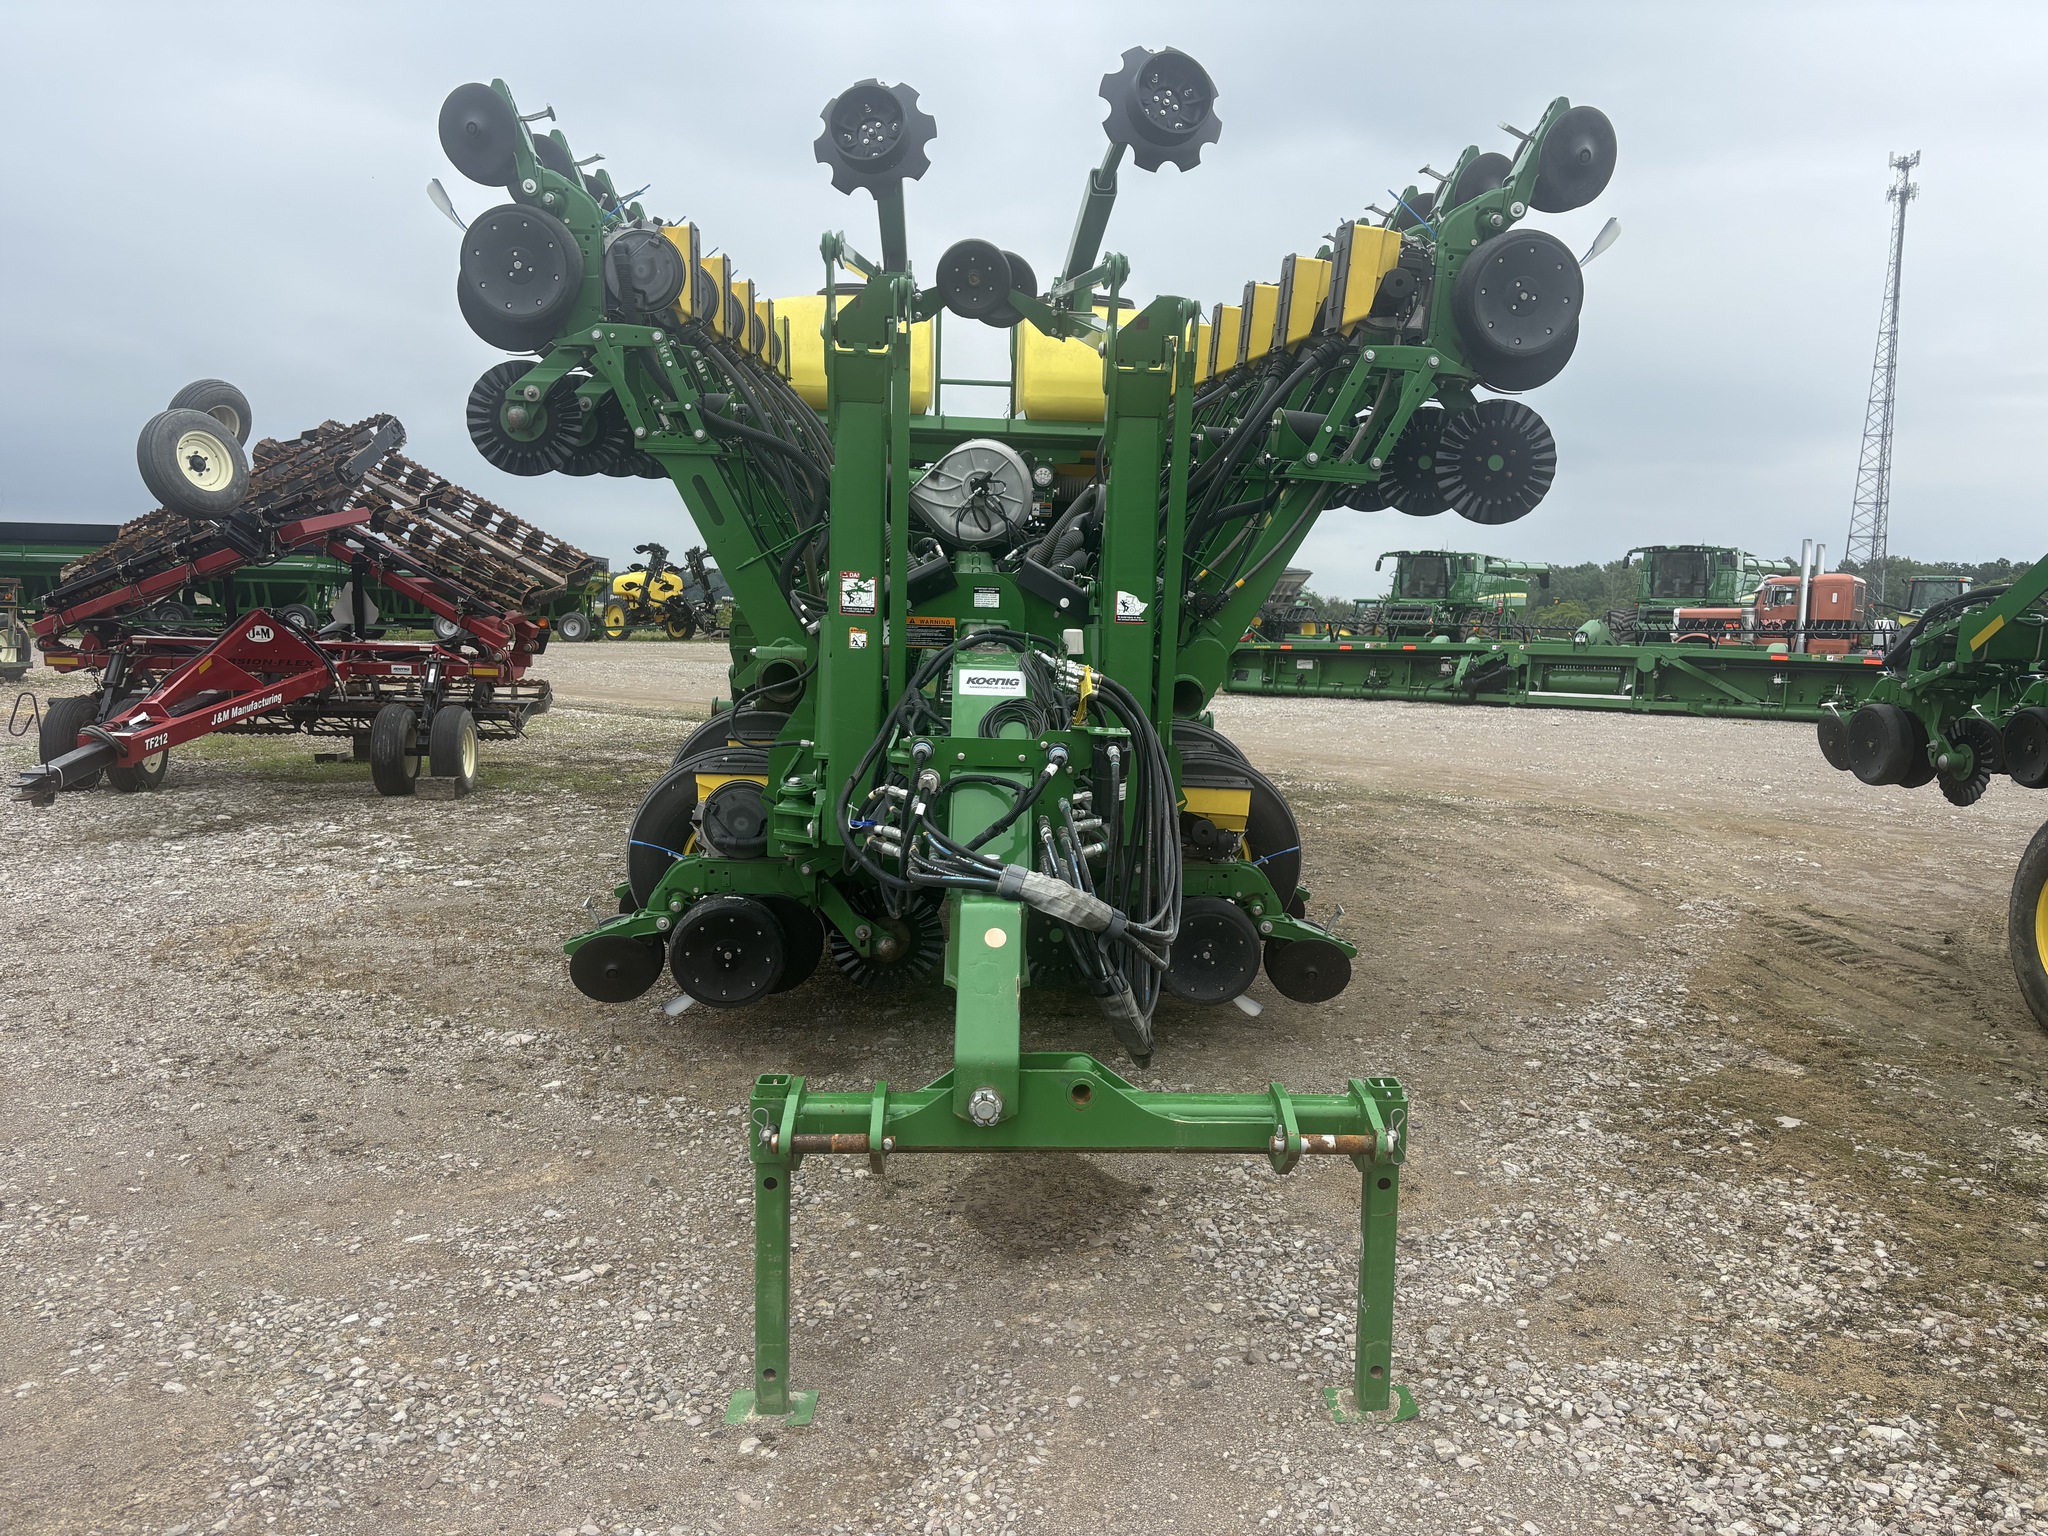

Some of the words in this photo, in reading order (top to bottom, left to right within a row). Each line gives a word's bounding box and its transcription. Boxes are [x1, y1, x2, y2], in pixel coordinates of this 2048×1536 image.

[248, 627, 271, 639] J&M
[211, 709, 230, 726] J&M
[231, 693, 282, 718] Manufacturing
[144, 732, 169, 751] TF212
